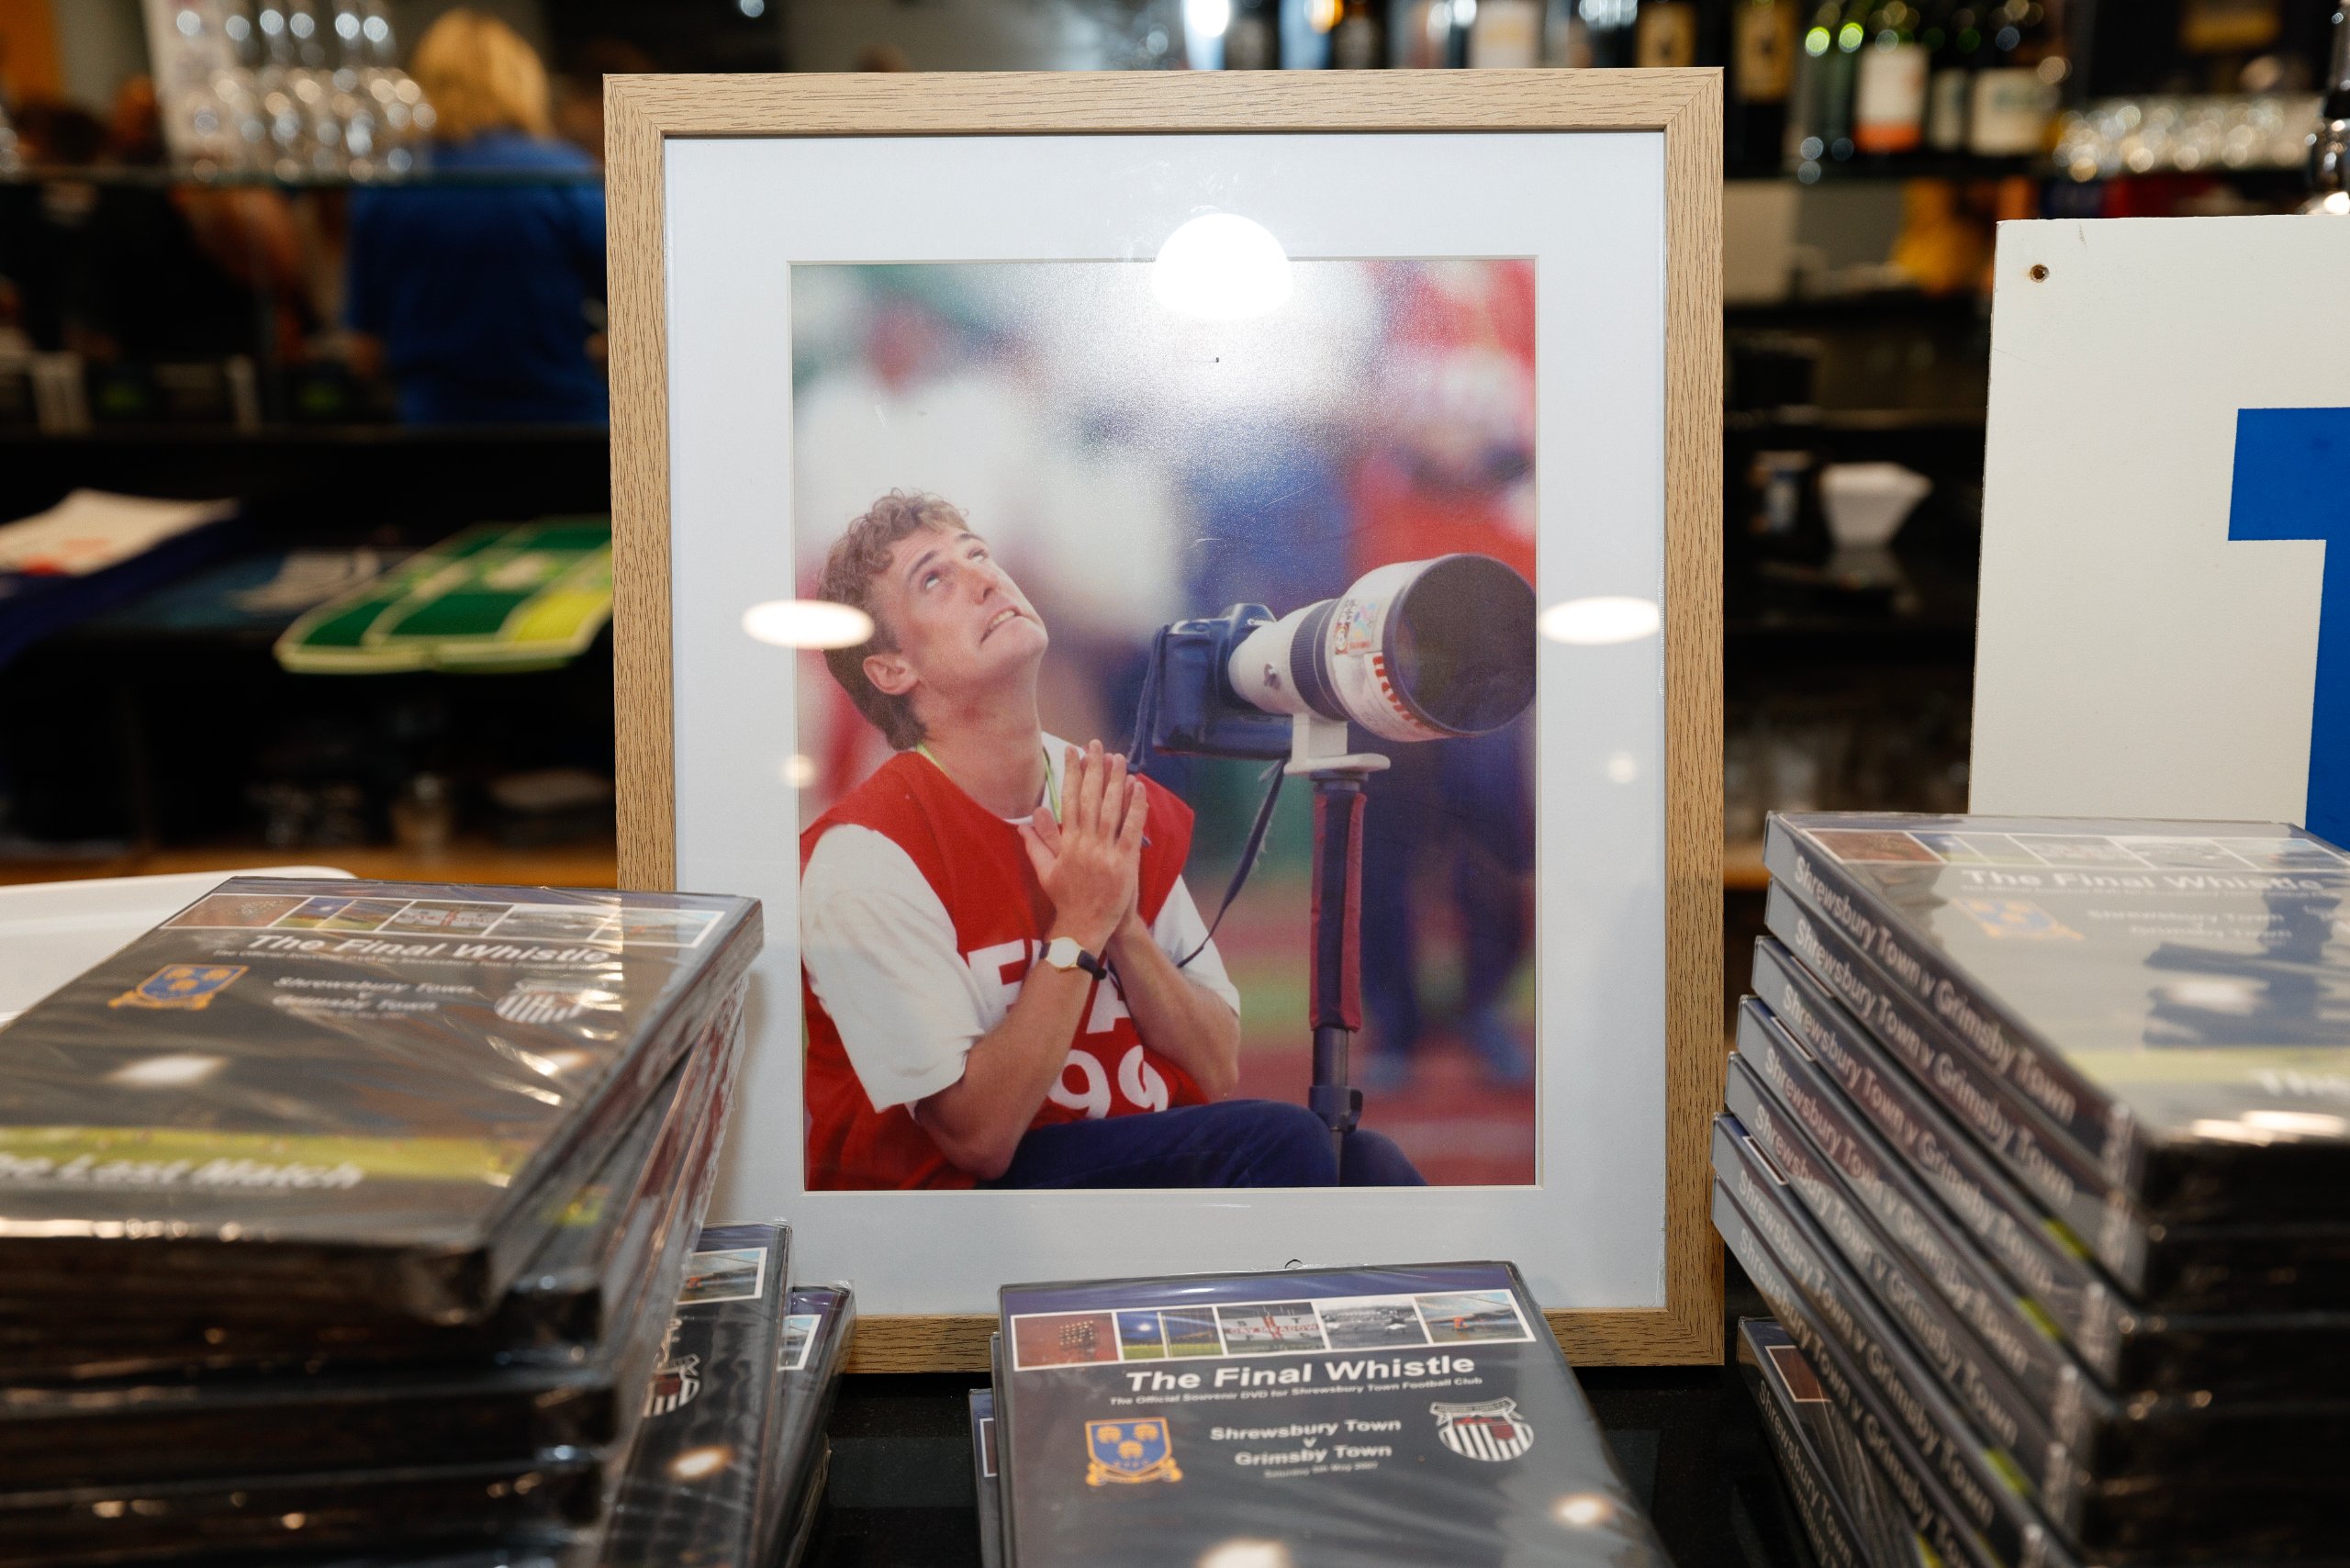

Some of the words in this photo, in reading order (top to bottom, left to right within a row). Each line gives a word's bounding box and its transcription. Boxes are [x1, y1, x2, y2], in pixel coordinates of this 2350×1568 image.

[248, 935, 325, 951] The
[332, 938, 448, 957] Final
[453, 943, 610, 962] Whistle
[1796, 856, 1878, 950] Shrewsbury
[1877, 925, 1921, 989] Town
[1934, 979, 2018, 1076] Grimsby
[2016, 1048, 2076, 1126] Town
[1783, 983, 1863, 1089] Shrewsbury
[1863, 1067, 1906, 1133] Town
[1796, 918, 1878, 1016] Shrewsbury
[1878, 994, 1921, 1056] Town
[1933, 1052, 2016, 1151] Grimsby
[1765, 1046, 1842, 1155] Shrewsbury
[1842, 1136, 1883, 1203] Town
[1755, 1103, 1831, 1217] Shrewsbury
[1832, 1195, 1874, 1267] Town
[1739, 1169, 1814, 1283] Shrewsbury
[1814, 1268, 1853, 1340] Town
[1110, 1396, 1133, 1406] The
[1136, 1394, 1180, 1405] Official
[1183, 1392, 1237, 1402] Souvenir
[1240, 1390, 1268, 1399] DVD
[1270, 1388, 1288, 1397] for
[1292, 1385, 1363, 1396] Shrewsbury
[1367, 1383, 1399, 1392] Town
[1402, 1378, 1451, 1390] Football
[1453, 1376, 1483, 1385] Club
[1126, 1371, 1201, 1392] The
[1214, 1363, 1312, 1388] Final
[1325, 1355, 1475, 1382] Whistle
[1812, 1333, 1851, 1406] Town
[1210, 1422, 1339, 1440] Shrewsbury
[1344, 1418, 1402, 1432] Town
[1234, 1448, 1328, 1466] Grimsby
[1333, 1445, 1393, 1459] Town
[1302, 1437, 1317, 1448] v
[1760, 1381, 1819, 1506] Shrewsbury
